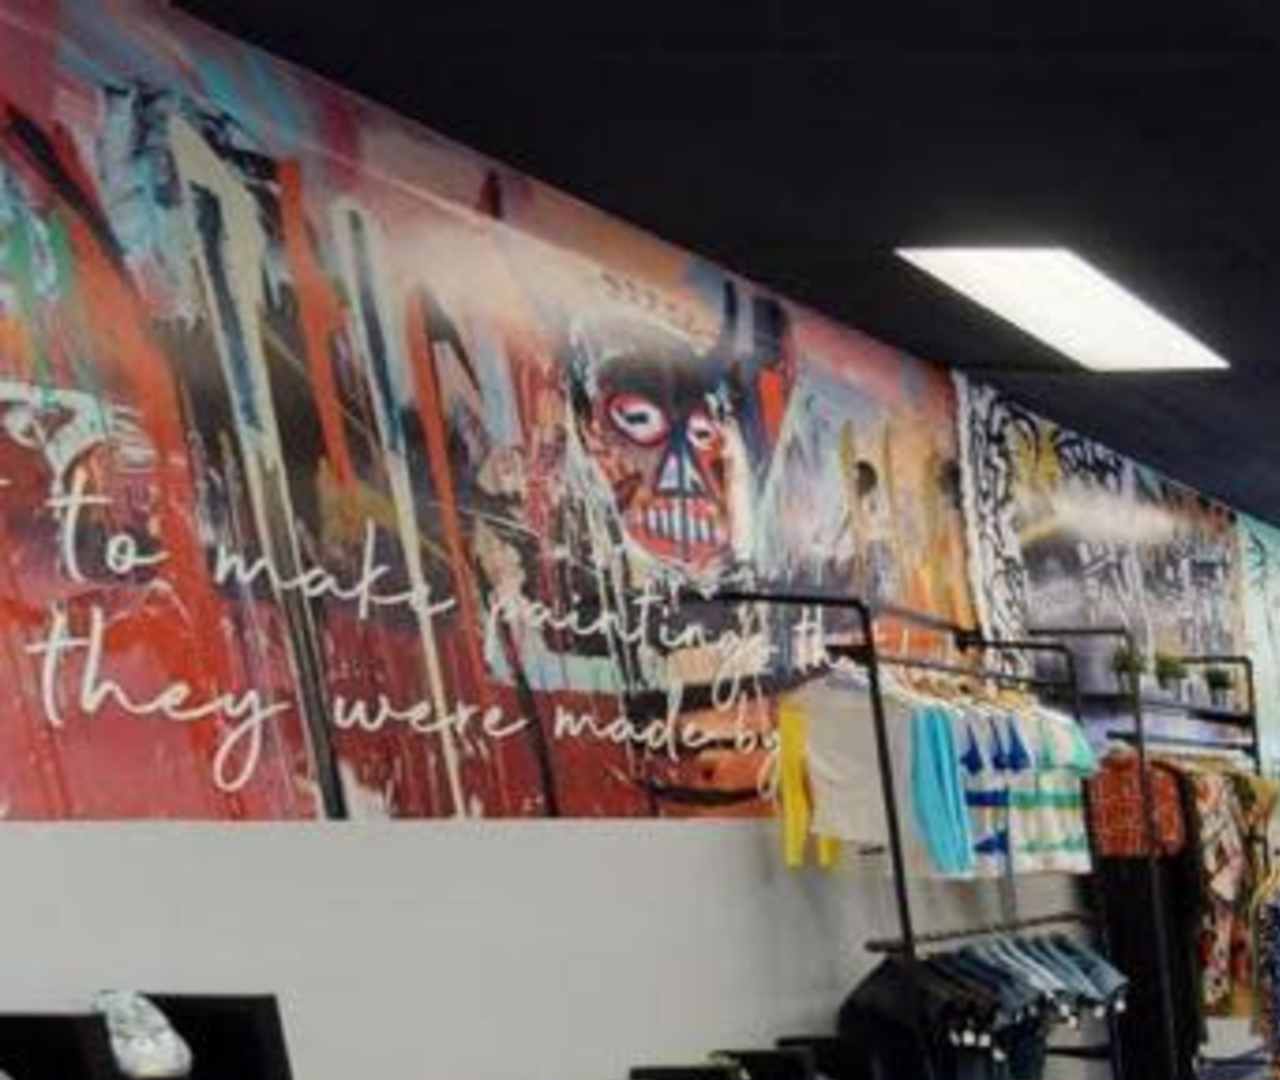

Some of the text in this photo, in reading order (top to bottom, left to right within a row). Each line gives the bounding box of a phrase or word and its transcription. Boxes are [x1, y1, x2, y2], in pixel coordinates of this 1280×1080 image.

[45, 466, 169, 583] to
[216, 519, 456, 620] make
[27, 602, 290, 792] they
[333, 694, 528, 736] were
[554, 678, 720, 762] made
